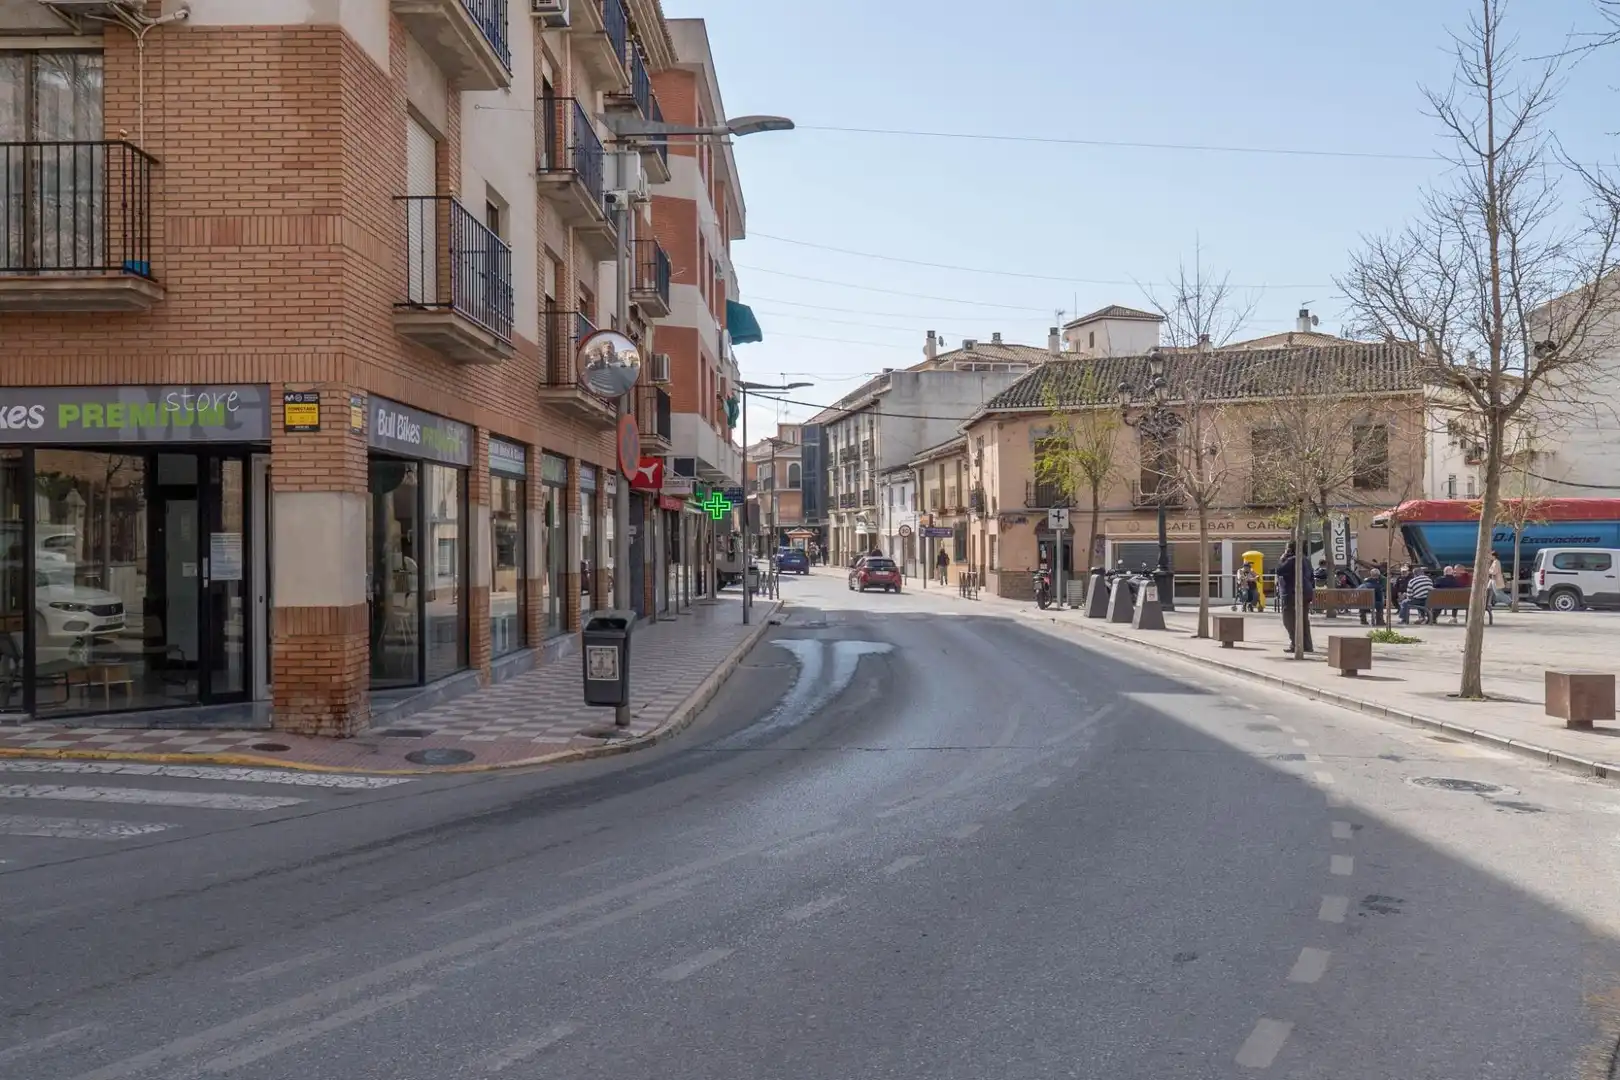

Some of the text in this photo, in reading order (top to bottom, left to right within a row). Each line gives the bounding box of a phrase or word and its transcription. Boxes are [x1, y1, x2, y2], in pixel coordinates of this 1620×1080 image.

[165, 387, 240, 412] store
[58, 401, 226, 429] PREMIUM
[377, 409, 396, 438] Bull
[396, 413, 421, 445] Bikes
[1208, 521, 1235, 531] BAR
